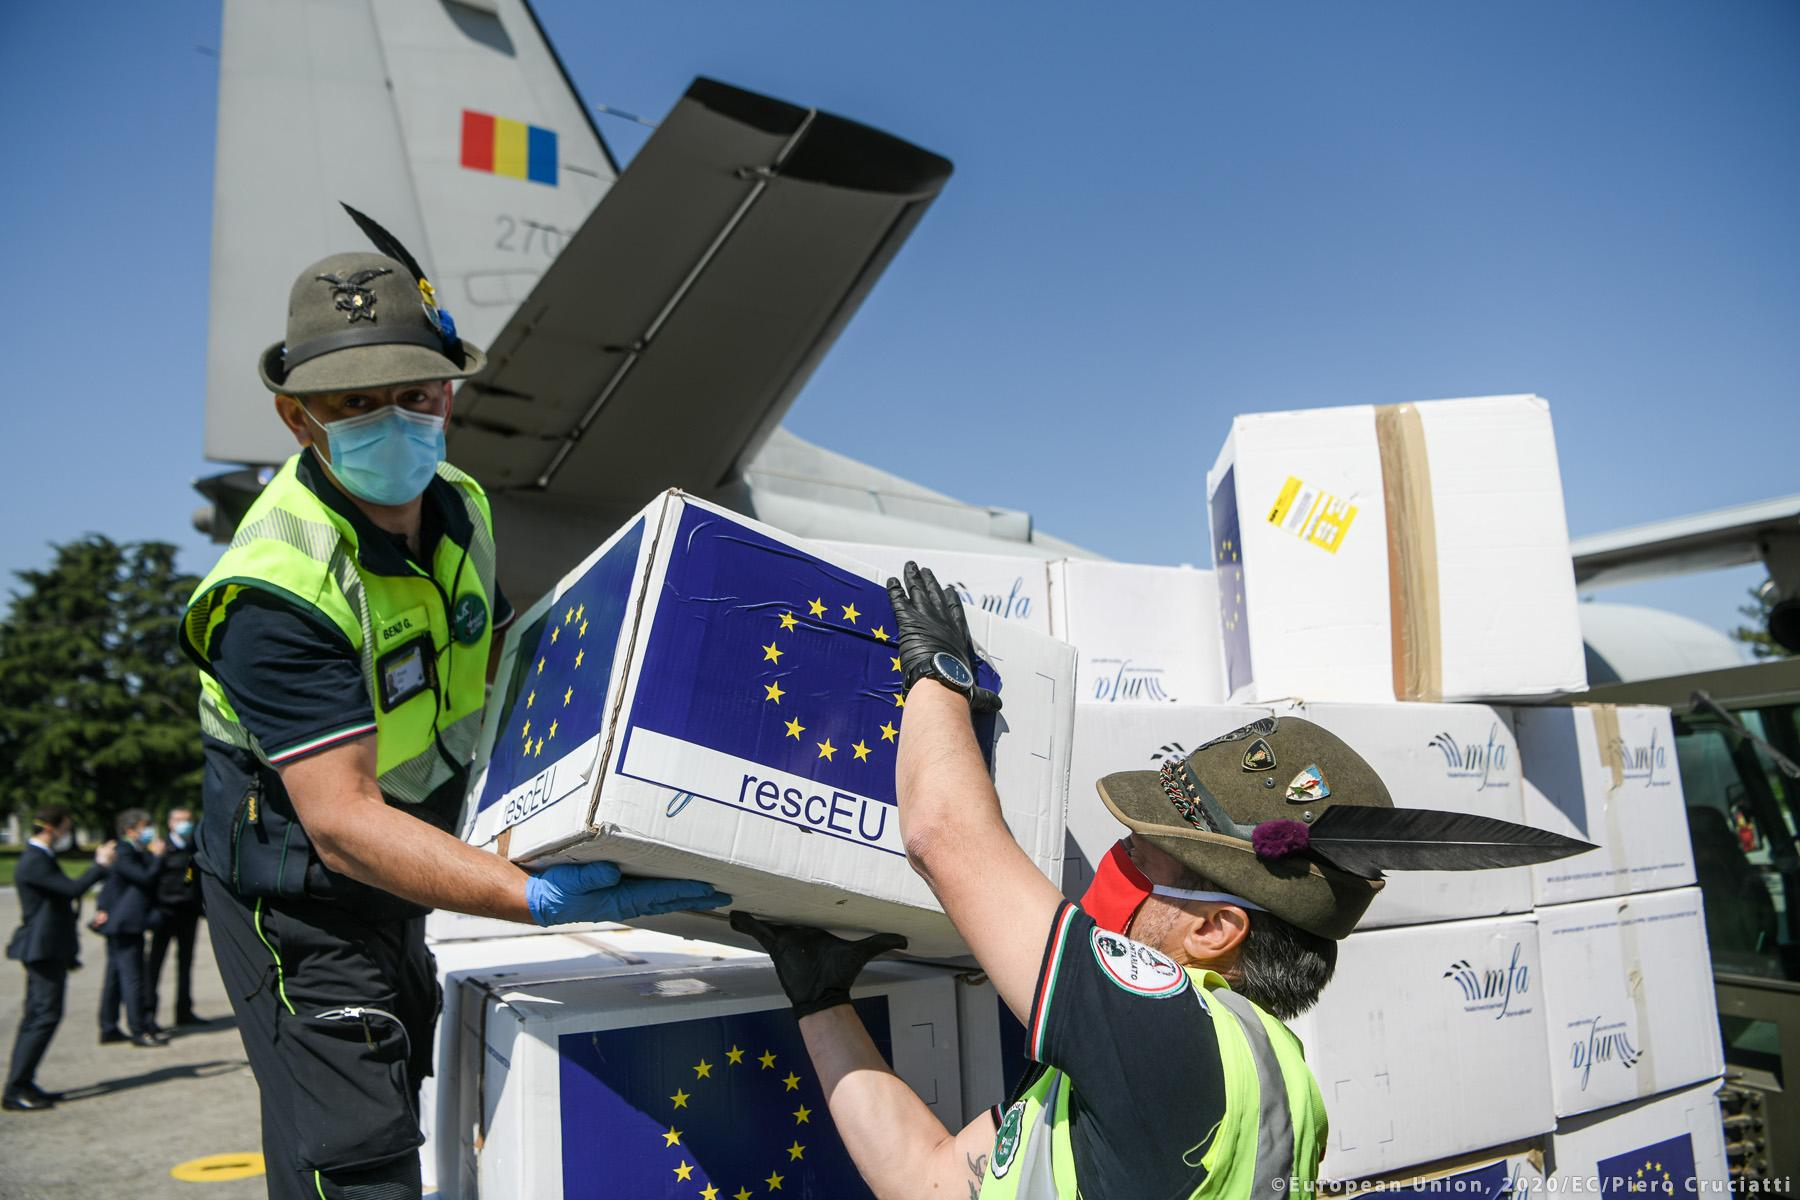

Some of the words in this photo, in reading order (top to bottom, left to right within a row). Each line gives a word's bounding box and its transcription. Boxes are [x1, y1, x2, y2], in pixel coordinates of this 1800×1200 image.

[495, 213, 563, 259] 270
[981, 576, 1031, 620] mfa
[1463, 721, 1506, 792] mfa
[1633, 727, 1666, 788] mfa
[503, 764, 557, 825] escEU
[738, 773, 887, 842] rescEU
[1484, 942, 1529, 1020] mfa
[1570, 1015, 1612, 1092] mfa
